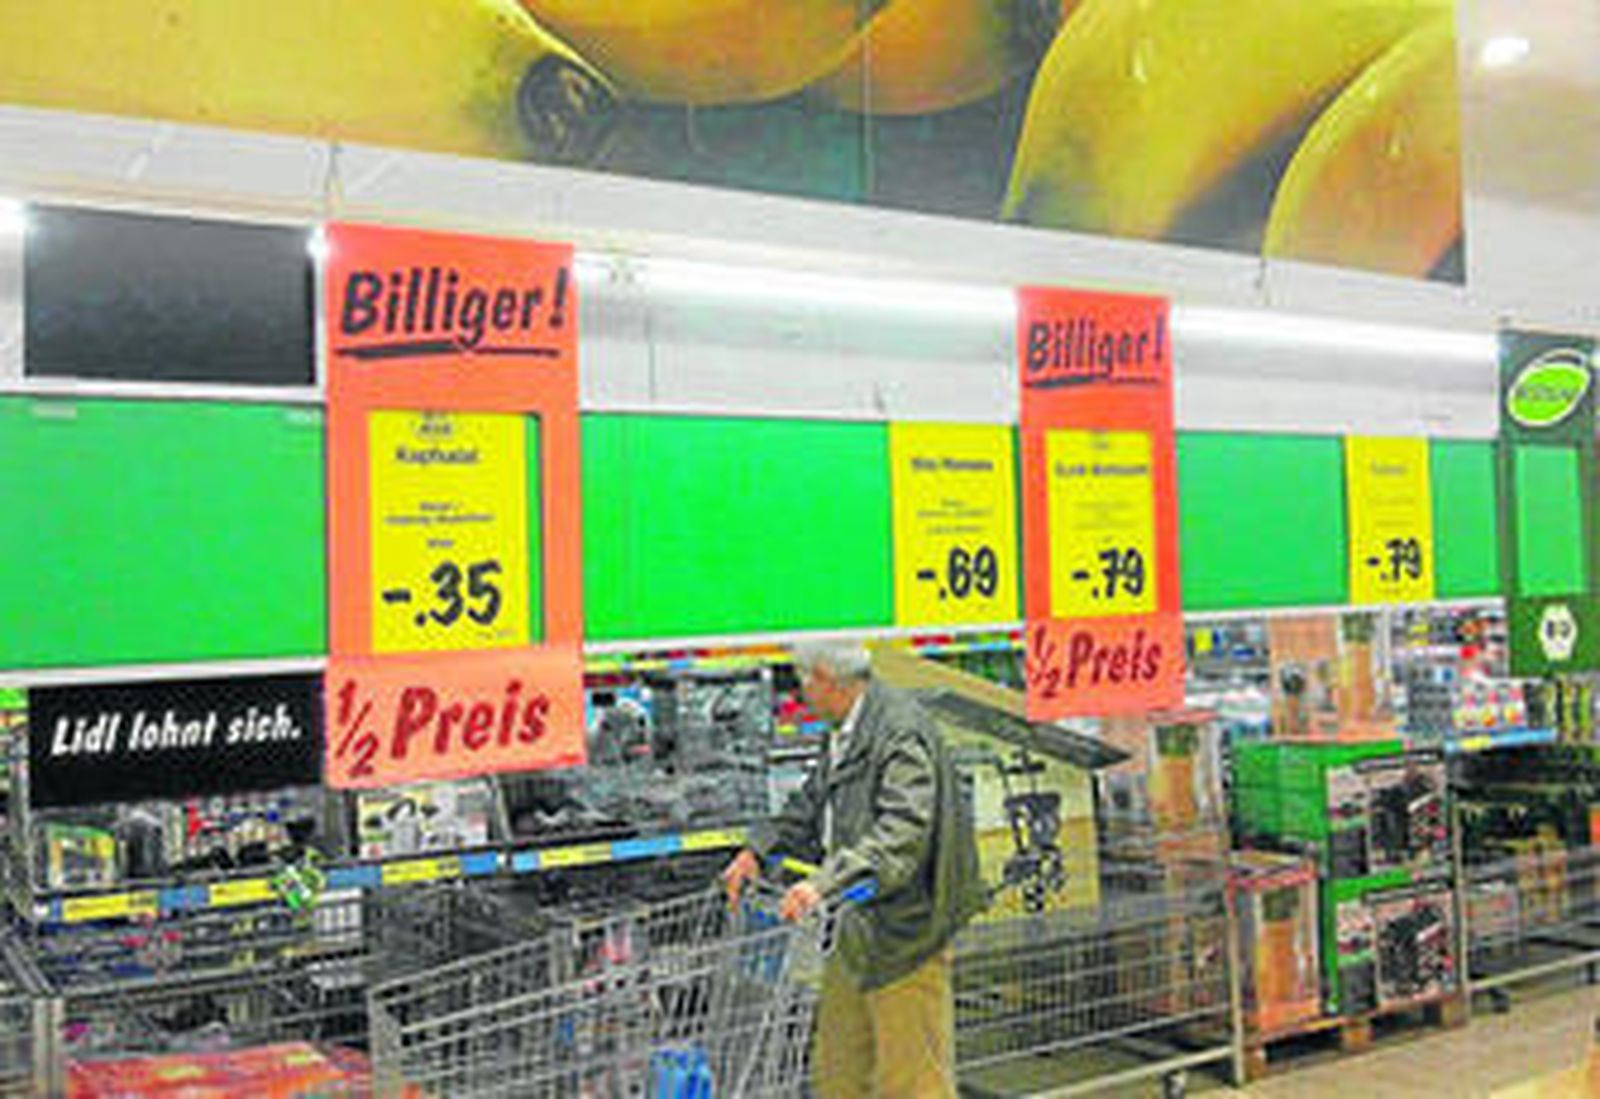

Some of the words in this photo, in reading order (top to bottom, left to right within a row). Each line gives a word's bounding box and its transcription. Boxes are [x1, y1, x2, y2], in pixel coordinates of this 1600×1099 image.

[341, 267, 568, 349] Billiger!
[1027, 314, 1166, 376] Billiger!
[381, 560, 502, 627] -.35
[1072, 547, 1144, 599] -.79
[1068, 628, 1161, 688] Preis
[51, 712, 121, 755] Lidl
[129, 710, 216, 750] lohnt
[227, 704, 301, 744] sich.
[391, 679, 549, 759] Preis
